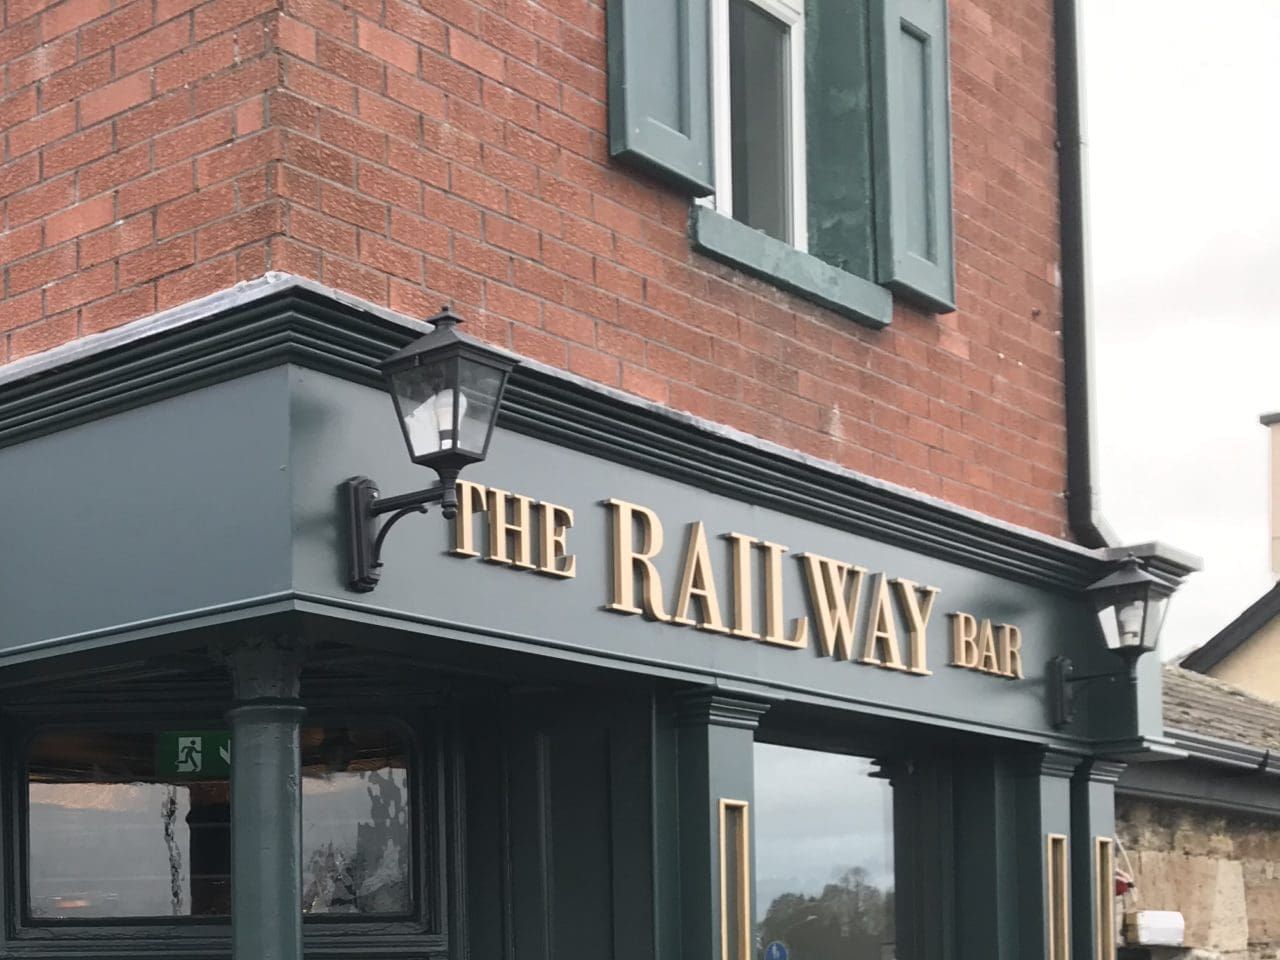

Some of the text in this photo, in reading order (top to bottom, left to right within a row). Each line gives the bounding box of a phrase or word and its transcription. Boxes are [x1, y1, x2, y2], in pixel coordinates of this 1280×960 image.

[454, 479, 1026, 680] THE RAILWAY BAR
